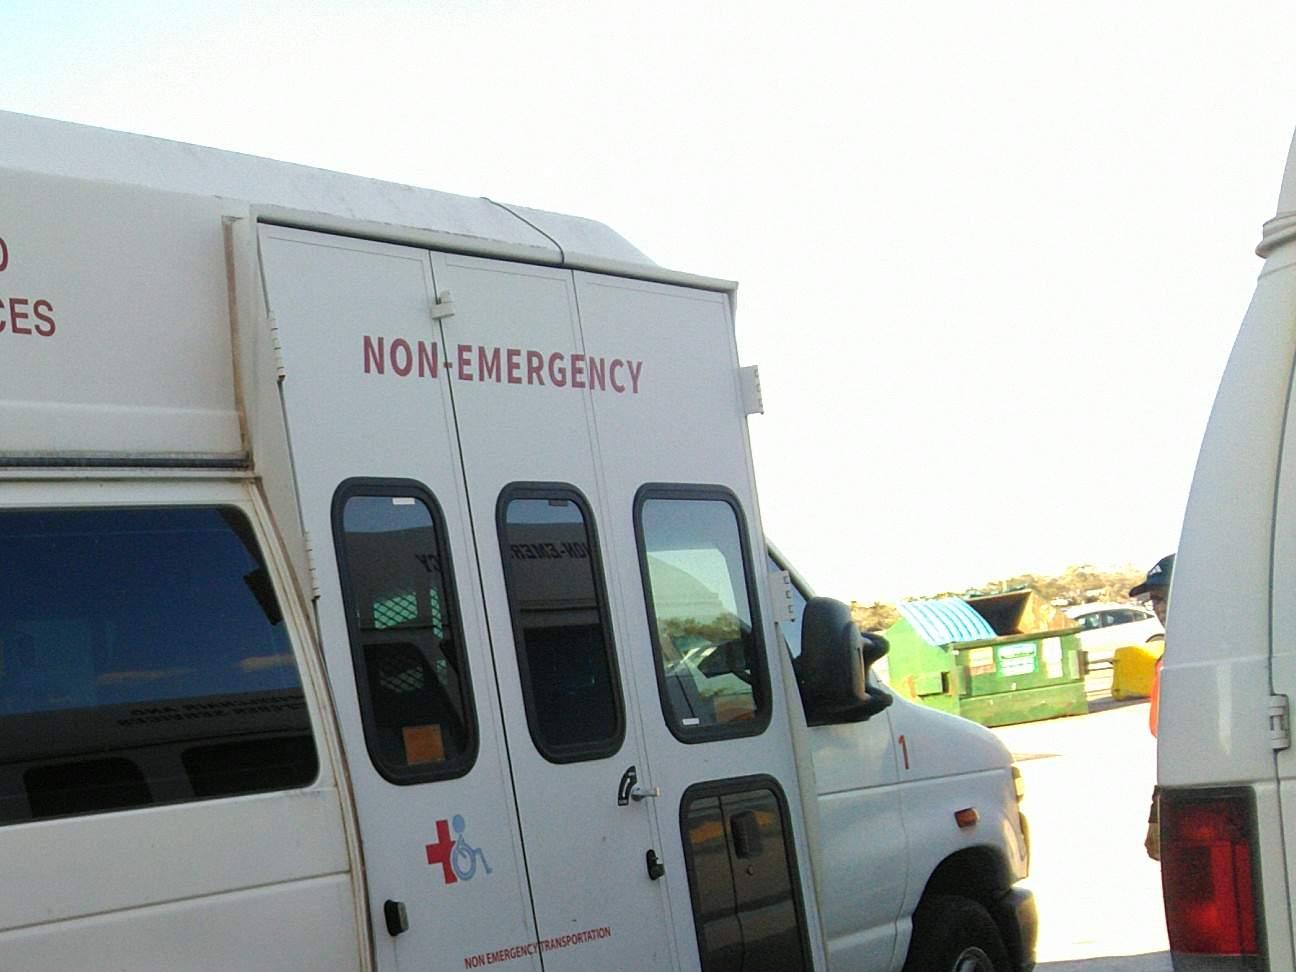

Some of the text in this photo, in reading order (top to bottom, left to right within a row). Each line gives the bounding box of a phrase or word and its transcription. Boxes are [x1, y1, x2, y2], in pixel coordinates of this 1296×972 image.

[363, 335, 643, 394] NON-EMERGENCY
[898, 735, 909, 770] 1
[464, 927, 612, 969] NON EMERGENCY TRANSPORTATION
